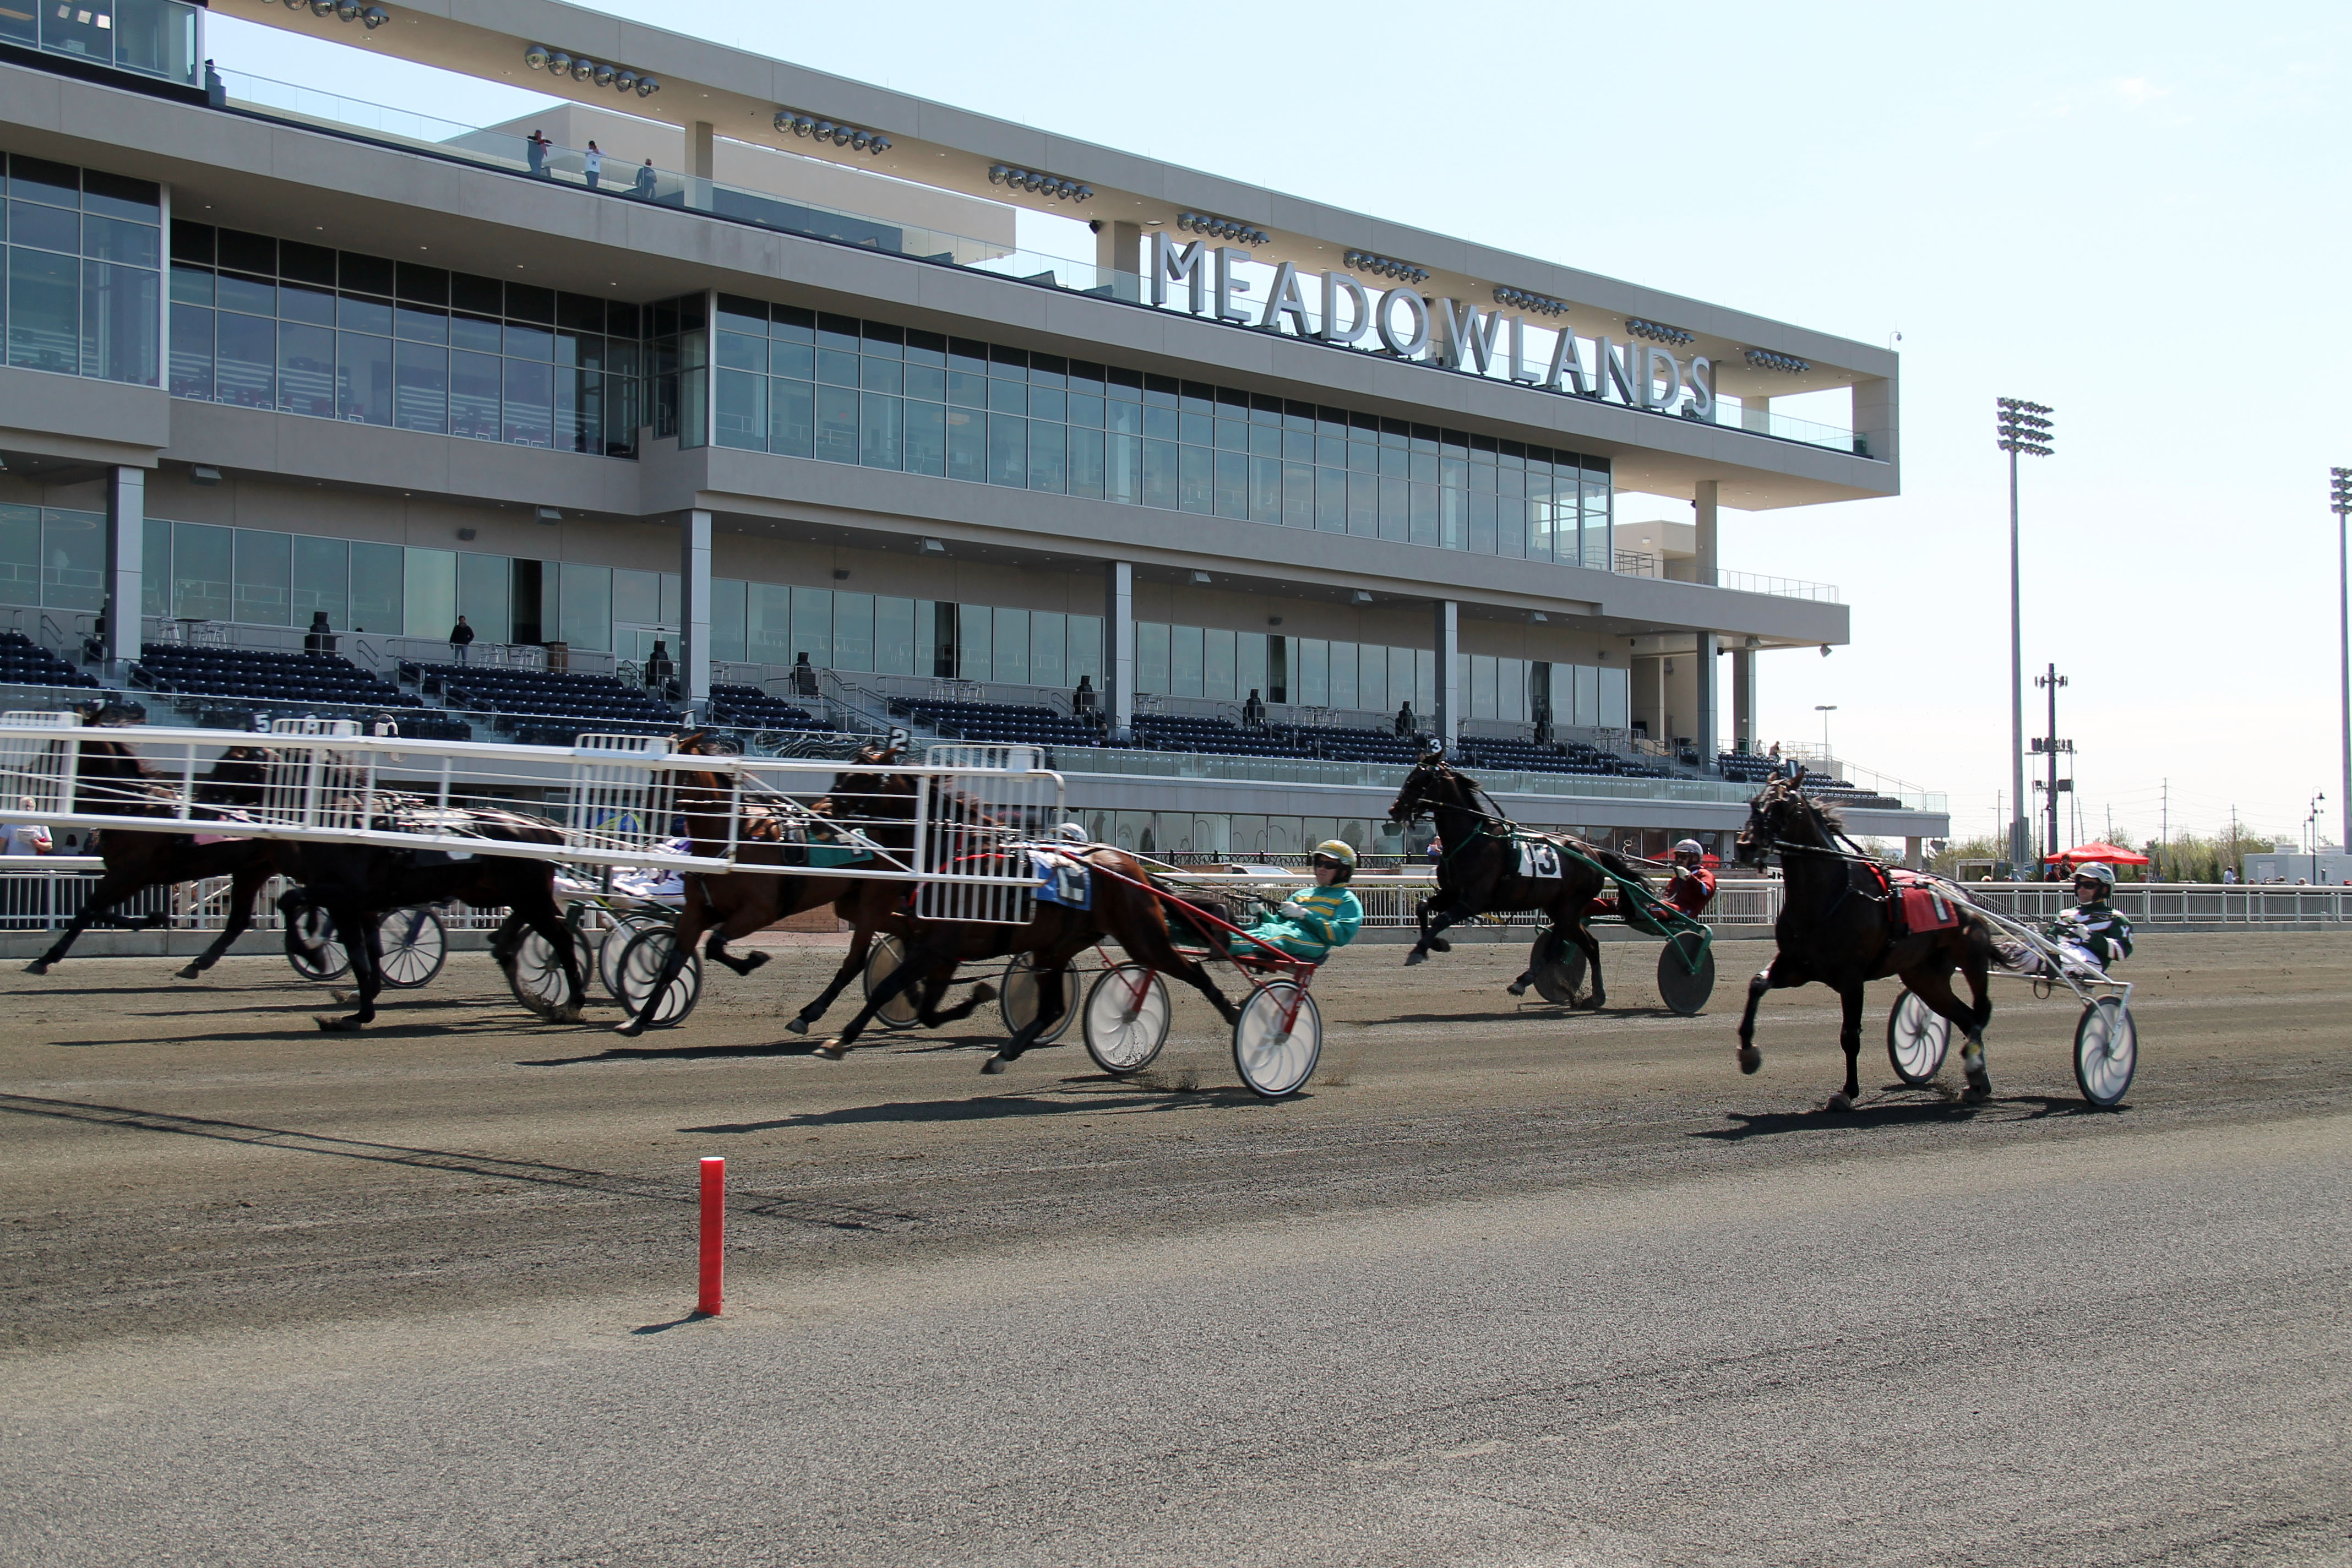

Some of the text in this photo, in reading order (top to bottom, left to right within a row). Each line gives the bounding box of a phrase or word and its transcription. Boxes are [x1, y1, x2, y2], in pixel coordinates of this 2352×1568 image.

[1151, 231, 1712, 417] MEADOWLANDS
[255, 714, 271, 732] 5
[683, 712, 695, 730] 4
[890, 728, 908, 752] 2
[1430, 739, 1442, 753] 3
